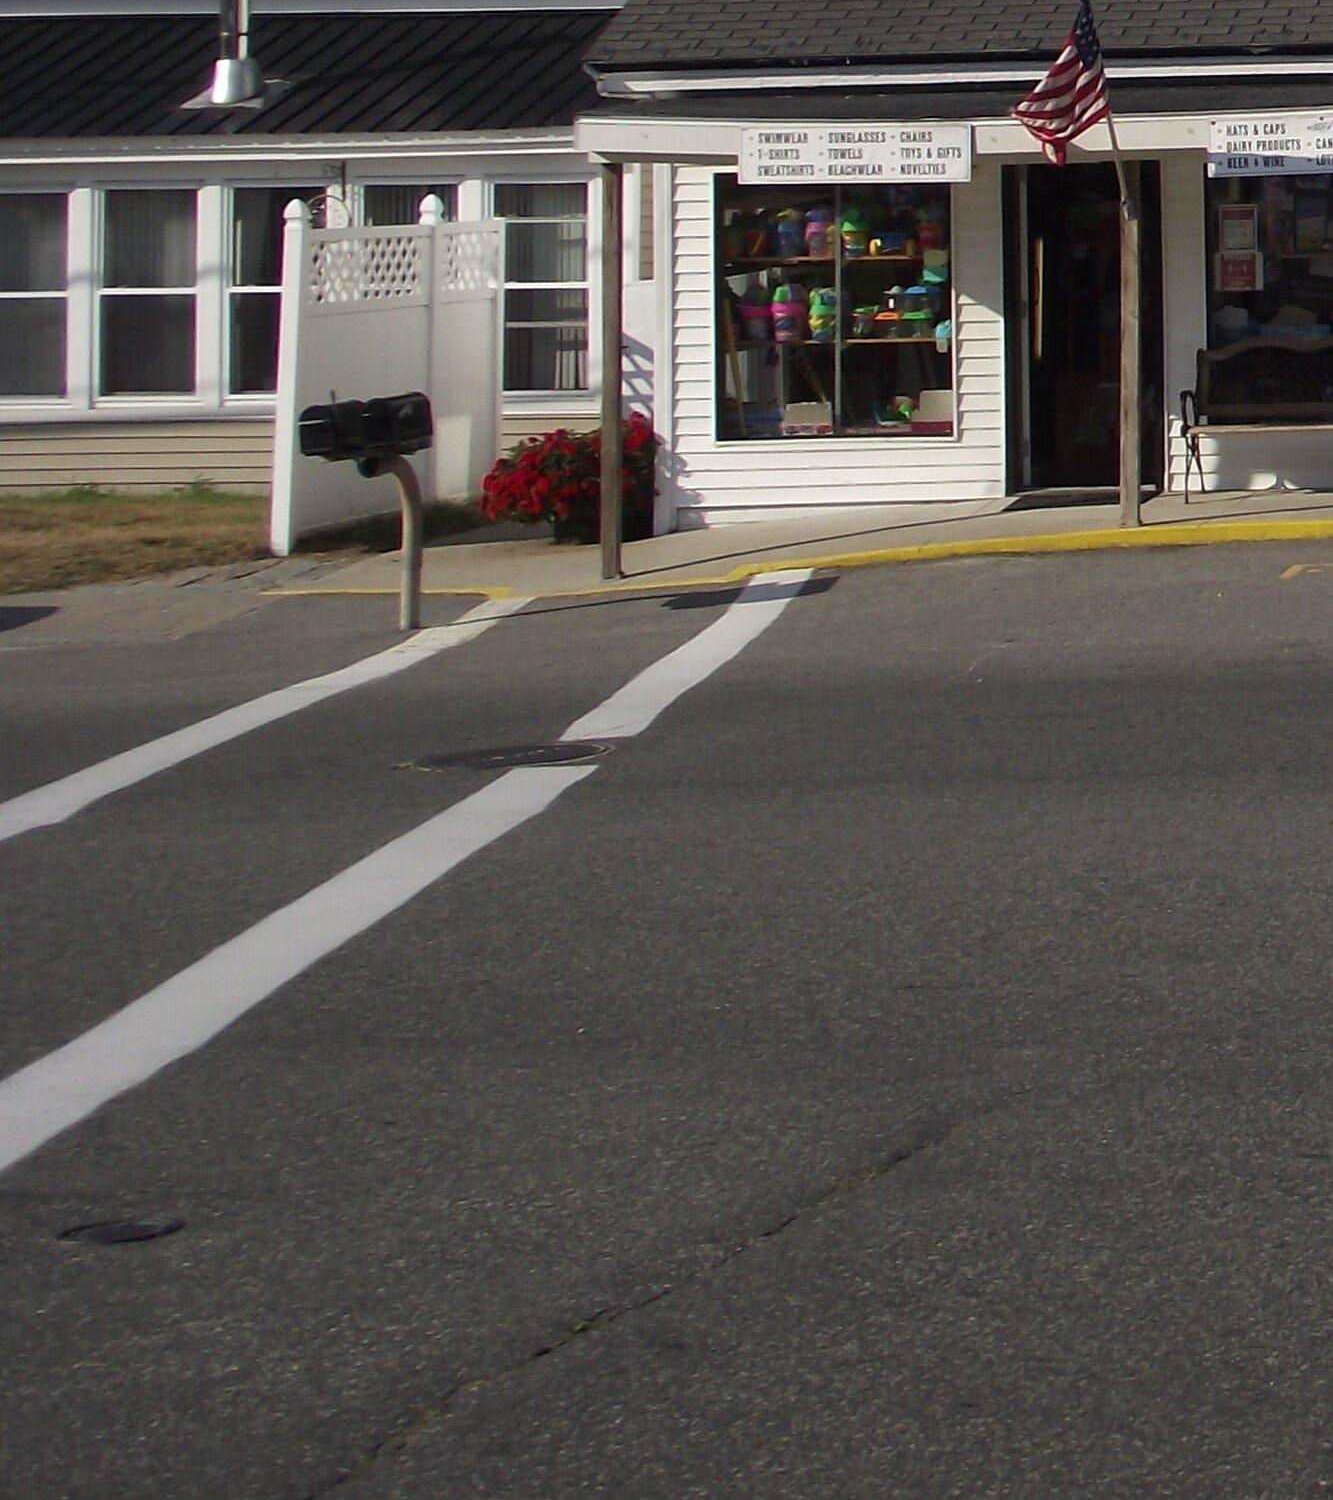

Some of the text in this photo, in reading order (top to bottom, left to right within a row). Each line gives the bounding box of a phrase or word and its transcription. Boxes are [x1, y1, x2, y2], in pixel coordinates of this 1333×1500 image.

[1253, 124, 1259, 136] &
[1263, 123, 1286, 135] CAPS
[758, 132, 809, 144] SWIMWEAR
[828, 131, 887, 144] SUNGLASSES
[900, 131, 933, 143] CHAIRS
[1226, 138, 1301, 153] DAIRY PRODUCTS
[758, 148, 800, 160] T-SHIRTS
[827, 148, 863, 160] TOWELS
[900, 147, 962, 159] TOYS & GIFTS
[1227, 156, 1249, 169] BEER
[1262, 155, 1285, 168] WINE
[758, 165, 815, 177] SWEATSHIRTS
[828, 164, 883, 176] BEACHWEAR
[900, 163, 946, 175] NOVELTIES
